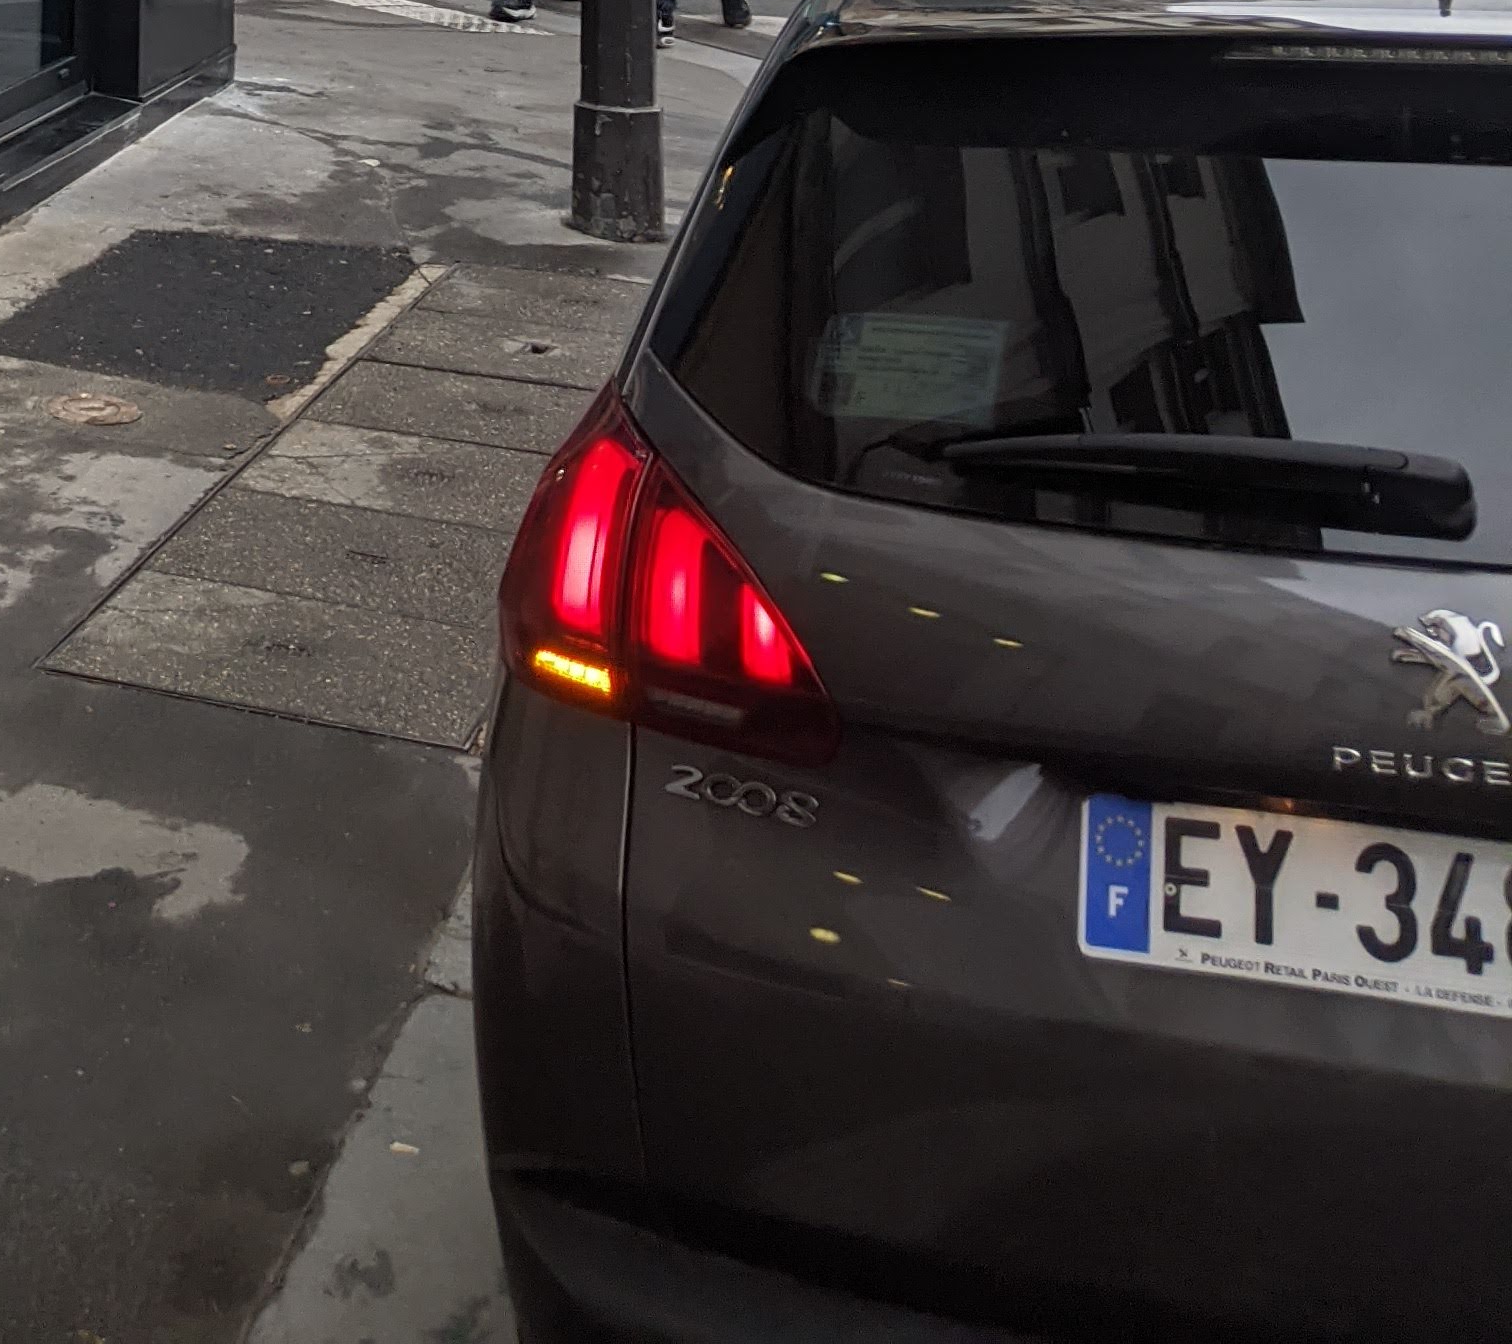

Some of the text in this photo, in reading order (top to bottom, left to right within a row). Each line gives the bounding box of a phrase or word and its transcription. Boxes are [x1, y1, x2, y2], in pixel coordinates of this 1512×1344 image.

[663, 764, 820, 828] 2008
[1107, 885, 1129, 918] F
[1162, 815, 1512, 977] EY-34
[1201, 952, 1260, 971] PEUGEOT
[1263, 960, 1308, 979] RETAIL
[1311, 968, 1351, 986] PARIS
[1354, 975, 1399, 993] OUEST
